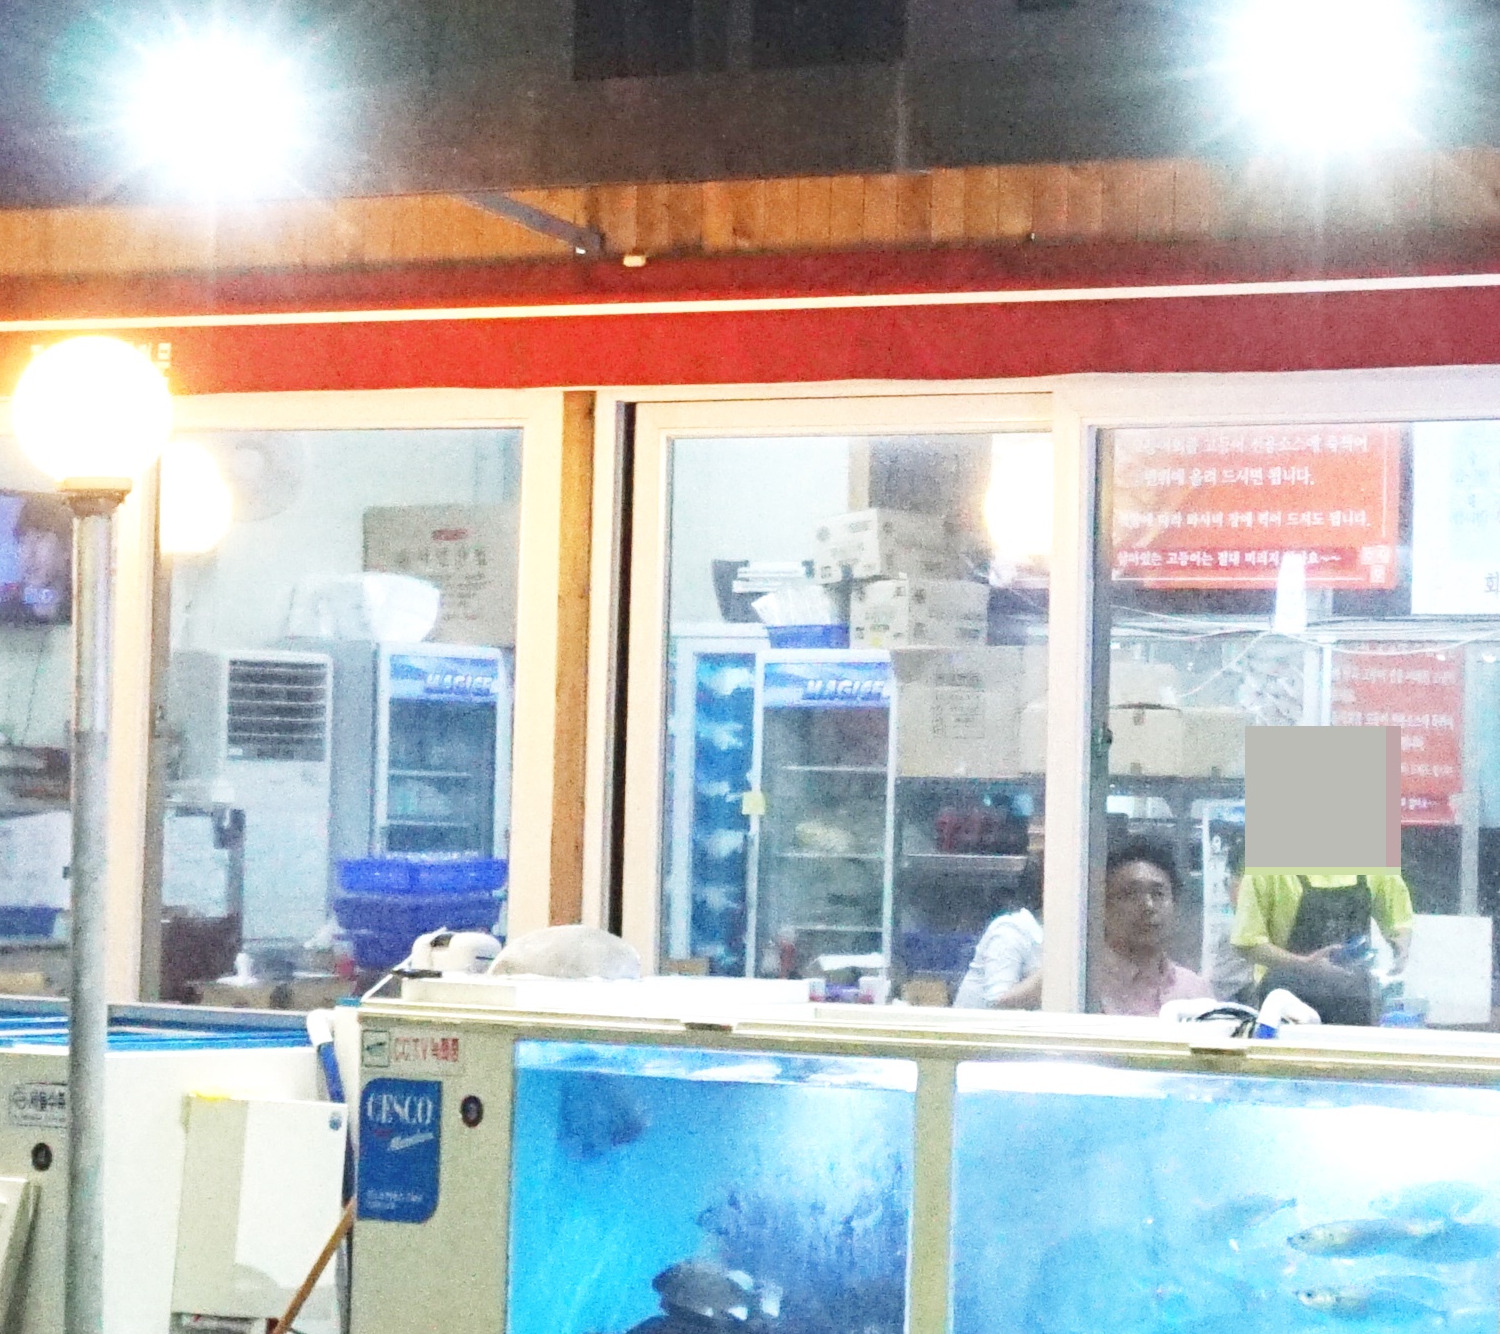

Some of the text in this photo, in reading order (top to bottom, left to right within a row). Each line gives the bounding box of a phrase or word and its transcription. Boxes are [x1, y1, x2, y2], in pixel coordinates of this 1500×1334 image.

[1267, 466, 1316, 486] 됩니다.
[1328, 509, 1372, 528] 됩니다.
[1165, 551, 1214, 567] 고등어는
[1483, 570, 1500, 598] 회
[366, 1092, 434, 1126] CESCO
